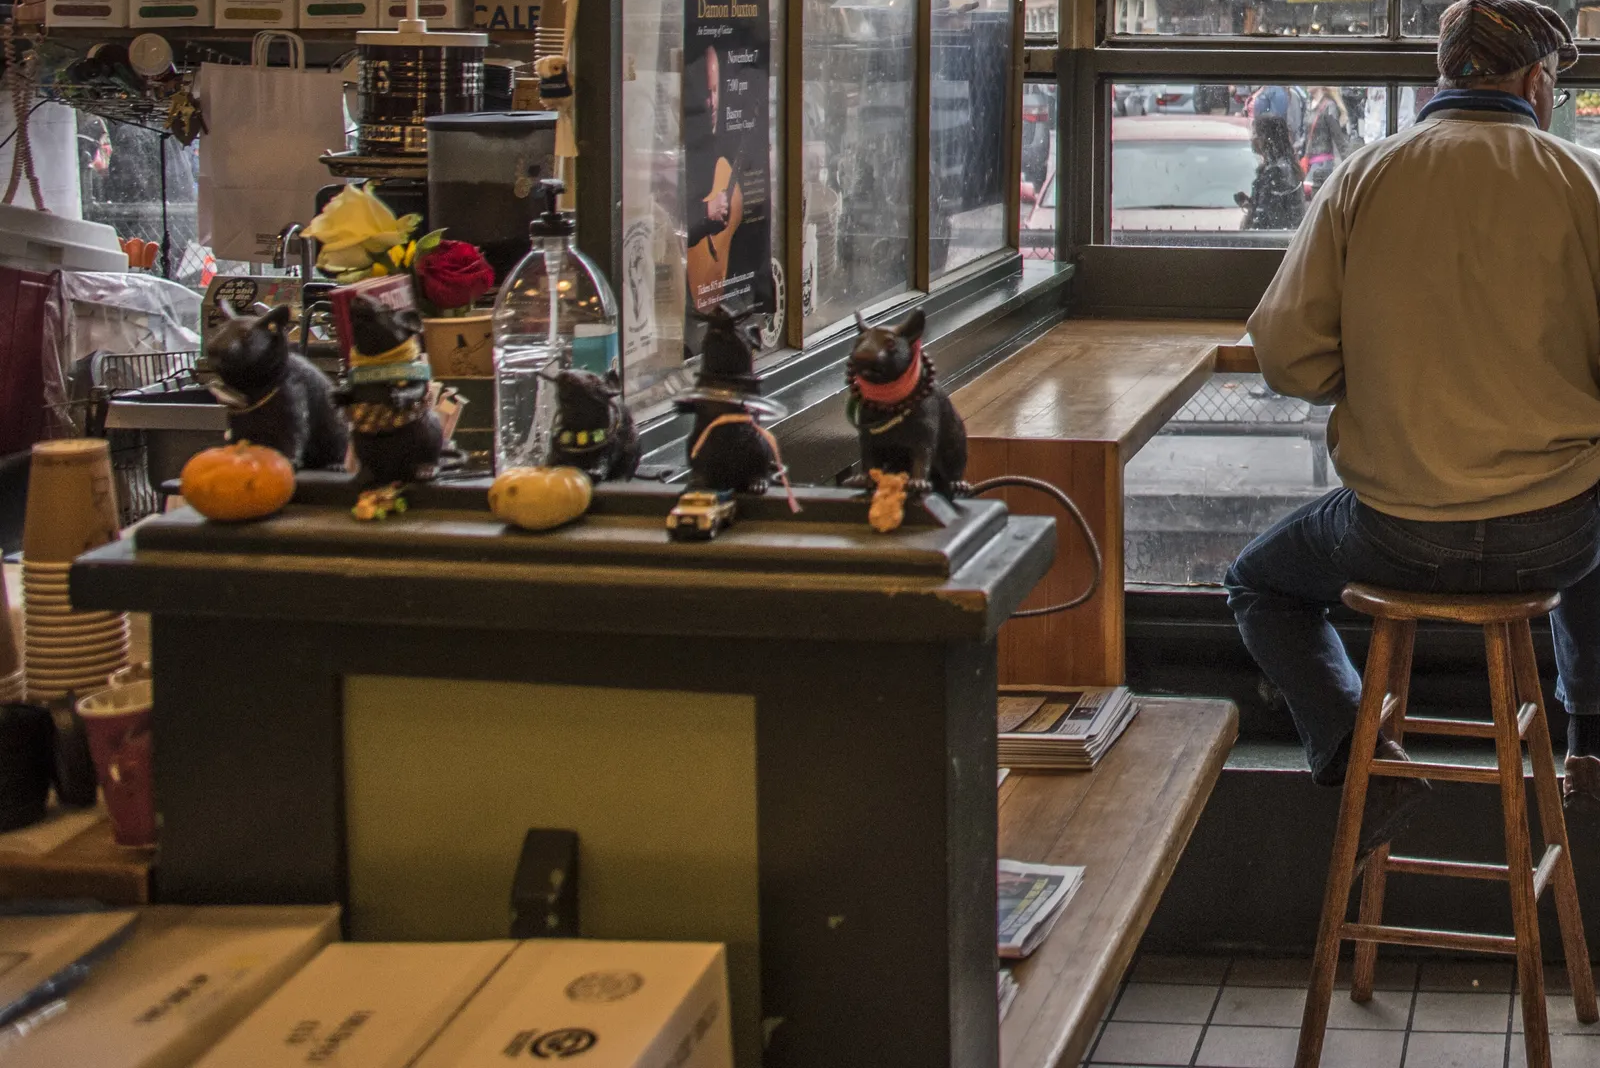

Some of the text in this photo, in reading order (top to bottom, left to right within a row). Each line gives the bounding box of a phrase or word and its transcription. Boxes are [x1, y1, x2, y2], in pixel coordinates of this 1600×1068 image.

[728, 49, 753, 64] November
[726, 79, 749, 96] 7:00 pm
